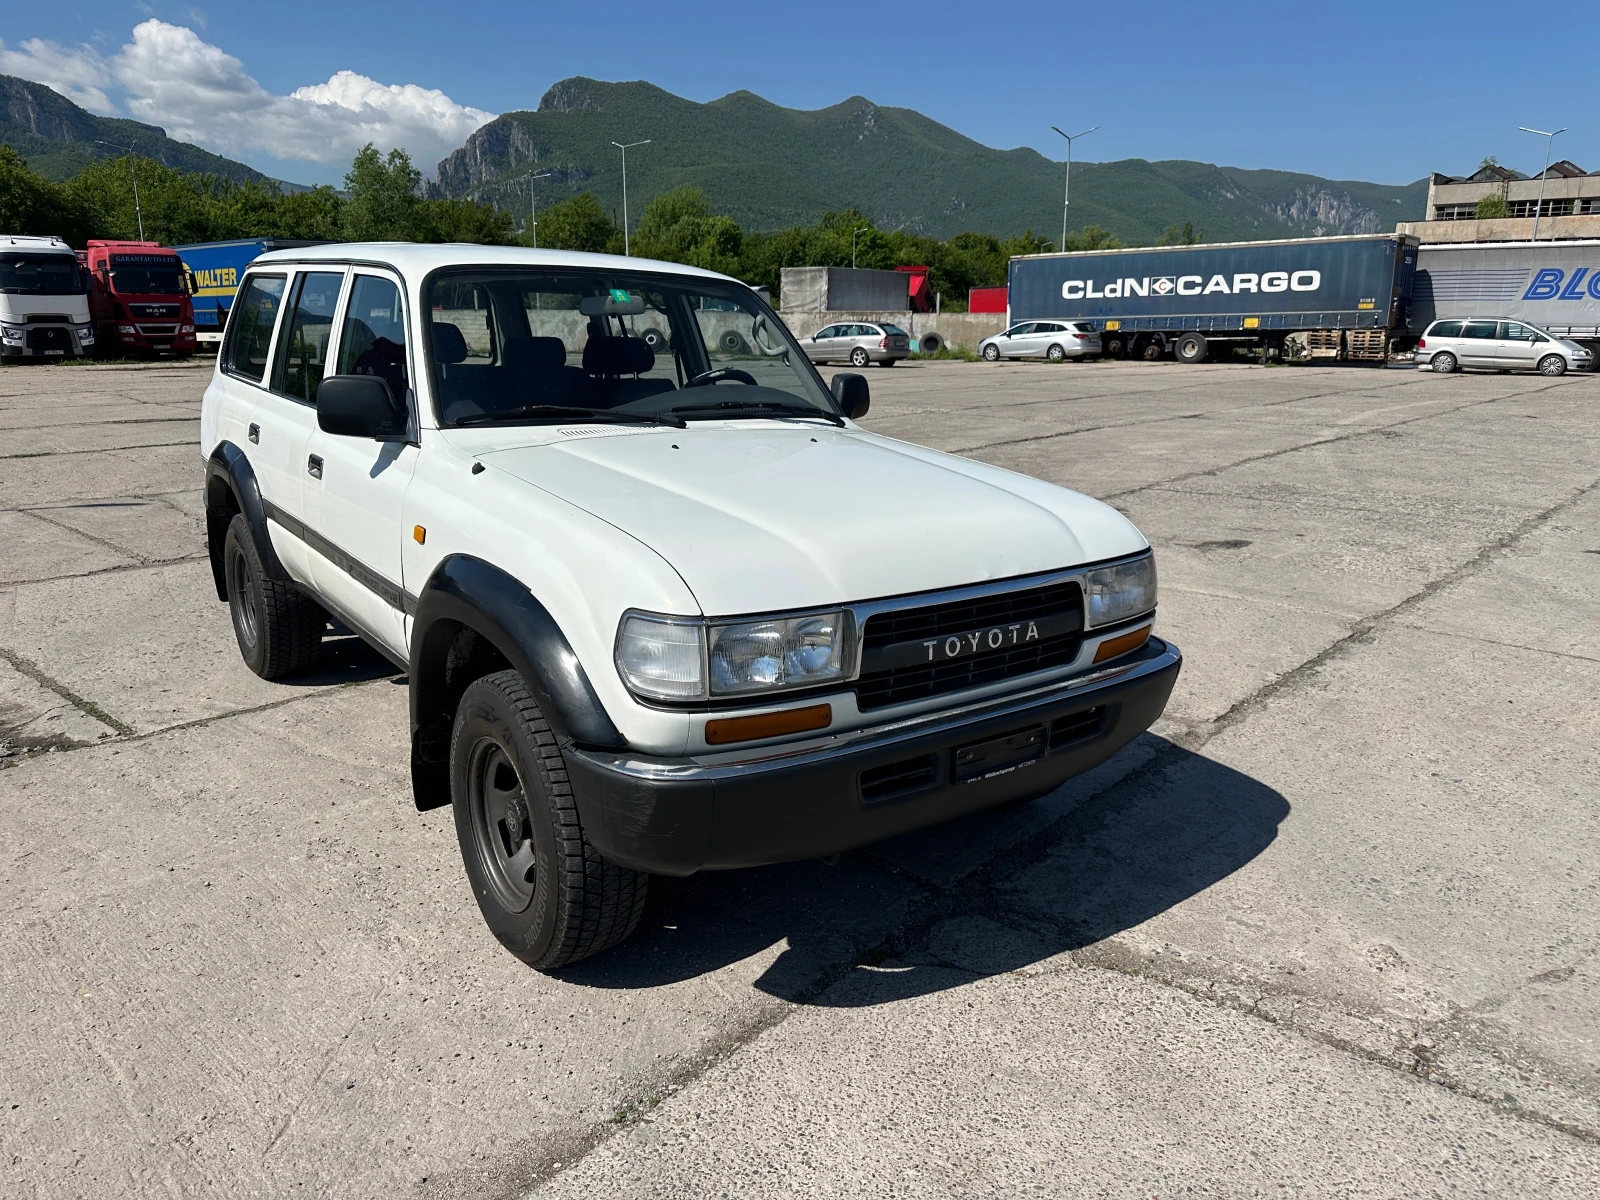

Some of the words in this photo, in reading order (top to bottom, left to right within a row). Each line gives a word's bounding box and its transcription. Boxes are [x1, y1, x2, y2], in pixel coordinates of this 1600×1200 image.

[194, 267, 238, 288] WALTER
[1061, 277, 1150, 300] CLdN
[1176, 270, 1321, 297] CARGO
[923, 621, 1039, 661] TOYOTA
[524, 850, 549, 949] BRIDGESTONE
